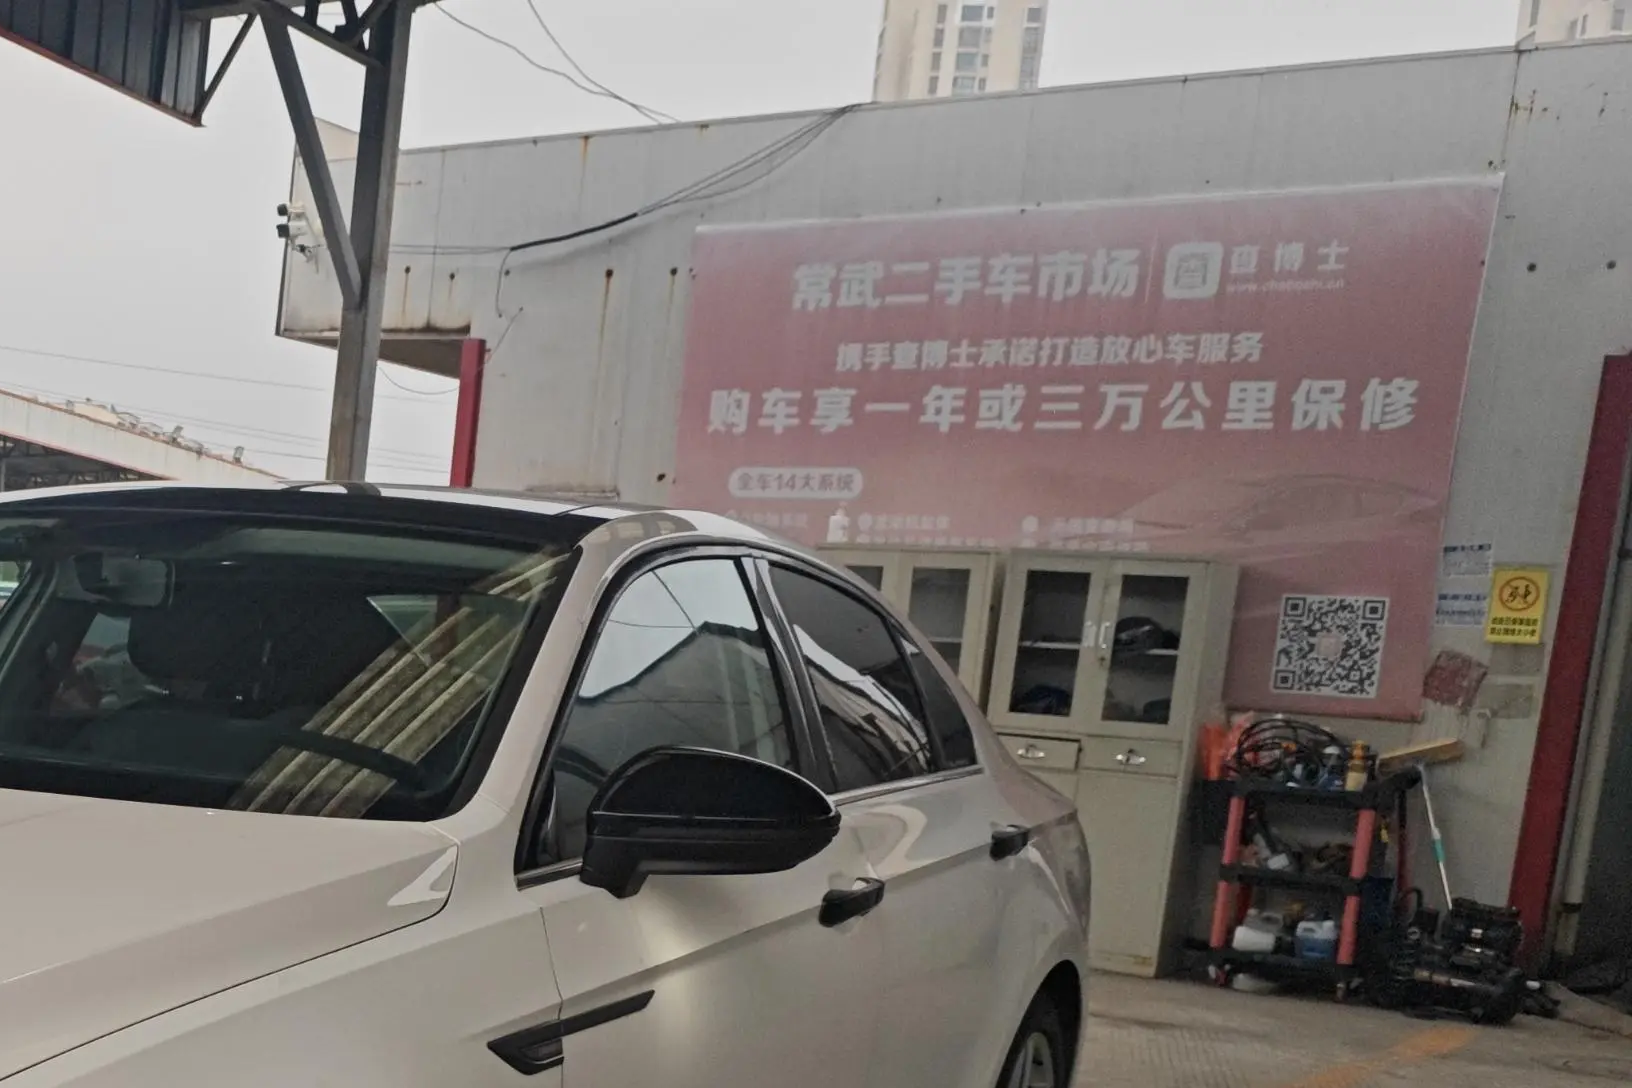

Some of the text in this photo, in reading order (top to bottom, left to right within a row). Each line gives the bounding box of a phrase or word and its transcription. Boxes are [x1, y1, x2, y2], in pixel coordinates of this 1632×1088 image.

[791, 248, 1142, 312] 常武二手车市场
[1228, 238, 1350, 275] 查博士
[705, 375, 1422, 436] 购车享一年或三万公里保修
